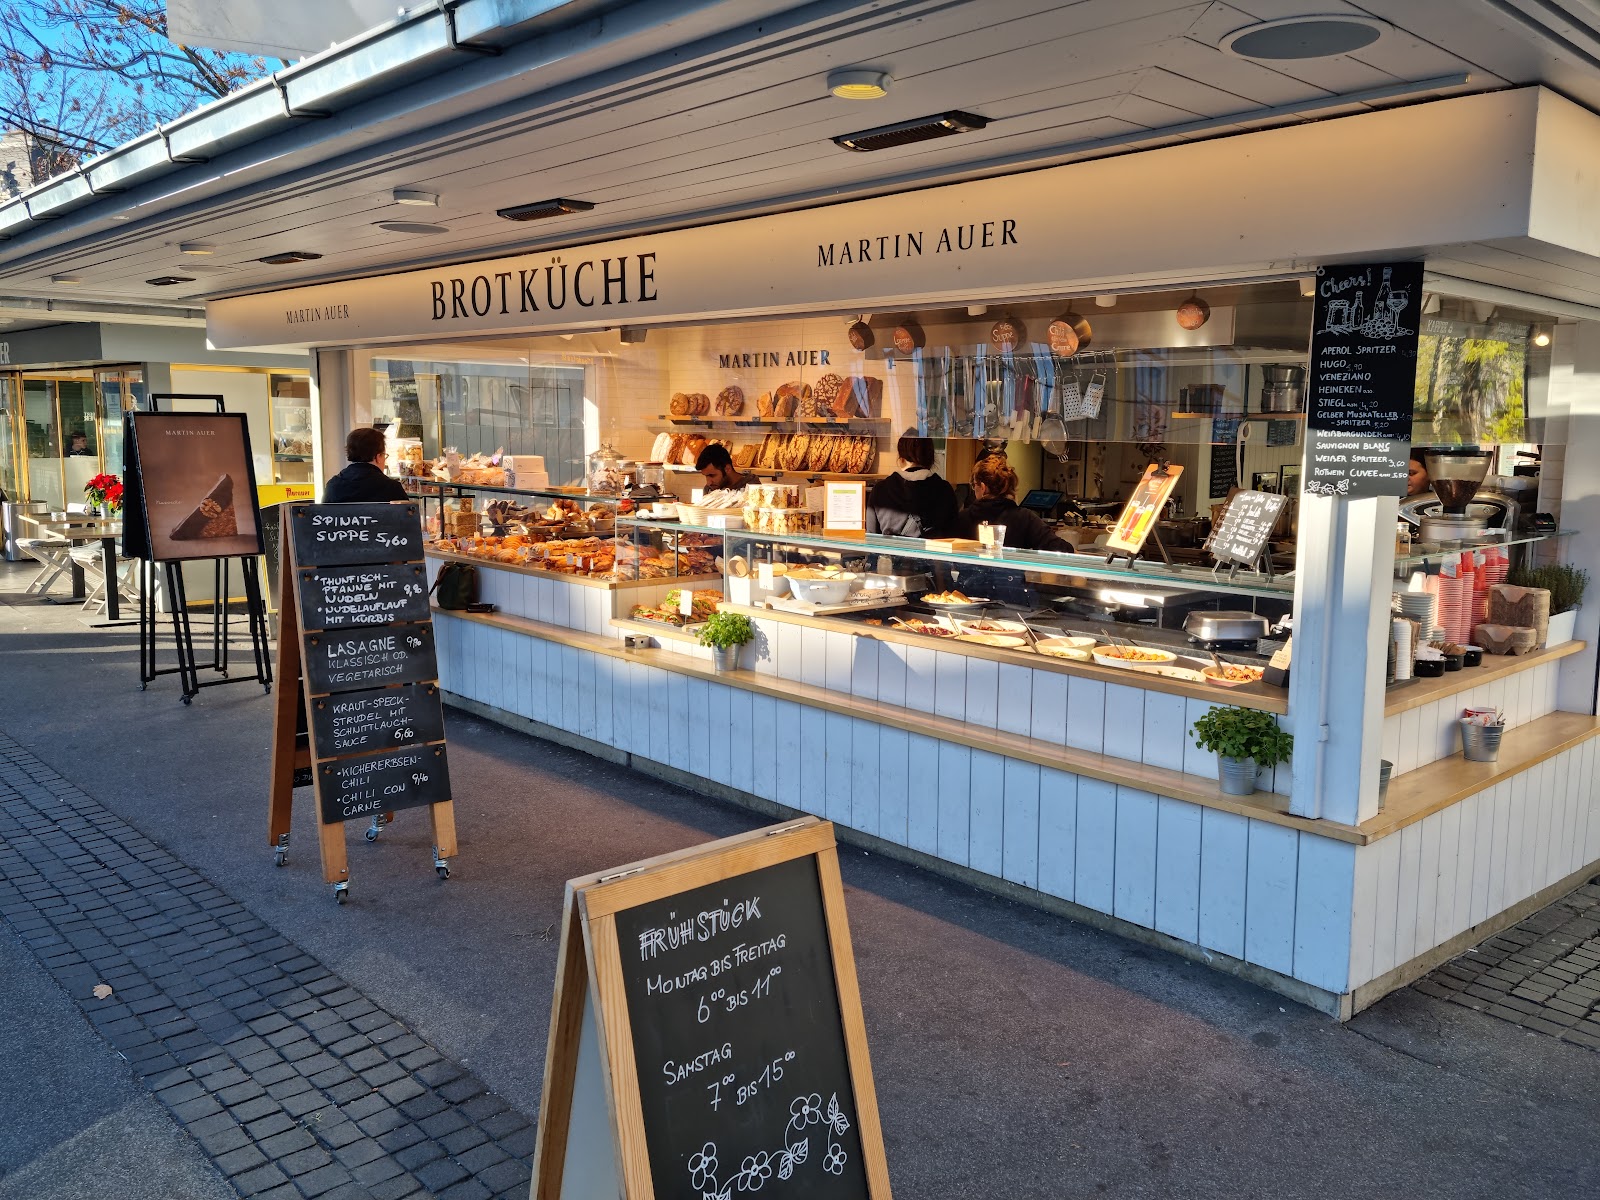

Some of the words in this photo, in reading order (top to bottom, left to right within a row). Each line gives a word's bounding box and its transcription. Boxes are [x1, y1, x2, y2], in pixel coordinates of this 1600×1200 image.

[818, 231, 923, 267] MARTIN
[935, 219, 1018, 253] AUER
[431, 252, 658, 321] BROTKÜCHE
[1320, 267, 1371, 298] Cheers!
[286, 308, 322, 323] MARTIN
[324, 304, 350, 321] AUER
[1321, 346, 1352, 355] APEROL
[1355, 345, 1397, 354] SPRITZER
[719, 352, 779, 369] MARTIN
[786, 350, 831, 366] AUER
[1320, 360, 1346, 369] HUGO
[1320, 373, 1371, 381] VENEZIANO
[1318, 385, 1362, 393] HEINEKEN
[1318, 398, 1346, 407] STIEGL
[1315, 442, 1359, 450] SAUVIGNON
[1363, 442, 1390, 450] BLANC
[1351, 455, 1387, 463] SPRITZER
[1314, 467, 1345, 476] ROTWEIN
[312, 514, 379, 527] SPINAT-
[316, 530, 370, 542] SUPPE
[375, 532, 408, 548] 5,60
[322, 583, 373, 594] PFANNE
[378, 581, 397, 590] MIT
[325, 592, 379, 603] NUDELN
[325, 616, 345, 625] MIT
[327, 636, 396, 658] LASAGNE
[328, 652, 388, 669] KLASSISCH
[328, 664, 403, 684] VEGETARISCH
[333, 712, 382, 727] STRUDEL
[389, 707, 407, 717] MIT
[335, 736, 369, 749] SAUCE
[394, 728, 414, 741] 6,60
[341, 776, 370, 790] CHILI
[342, 789, 376, 804] CHILI
[383, 783, 406, 795] CON
[342, 800, 382, 817] CARNE
[646, 966, 707, 996] MONTAG
[710, 955, 732, 978] BIS
[733, 934, 786, 964] FREITAG
[726, 992, 748, 1012] BIS
[663, 1042, 731, 1086] SAMSTAG
[736, 1080, 757, 1105] BIS
